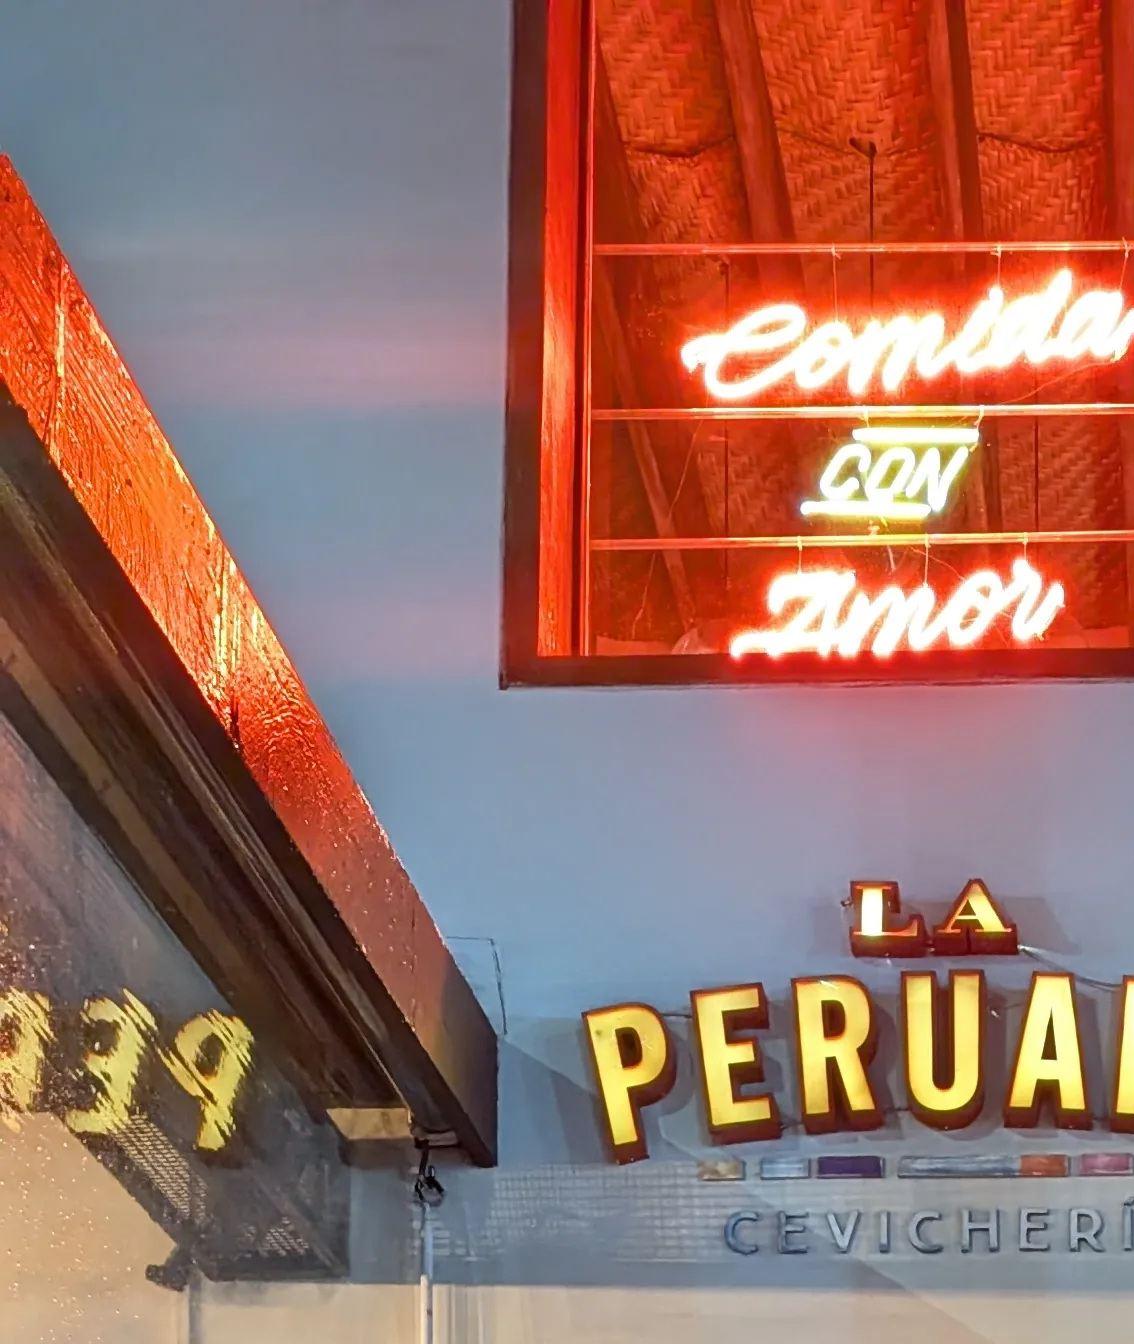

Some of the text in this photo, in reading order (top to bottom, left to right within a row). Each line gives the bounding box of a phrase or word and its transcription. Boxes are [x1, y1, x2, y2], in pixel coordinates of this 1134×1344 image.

[819, 443, 968, 512] CON
[730, 558, 1065, 661] Amor
[849, 878, 1019, 957] LA
